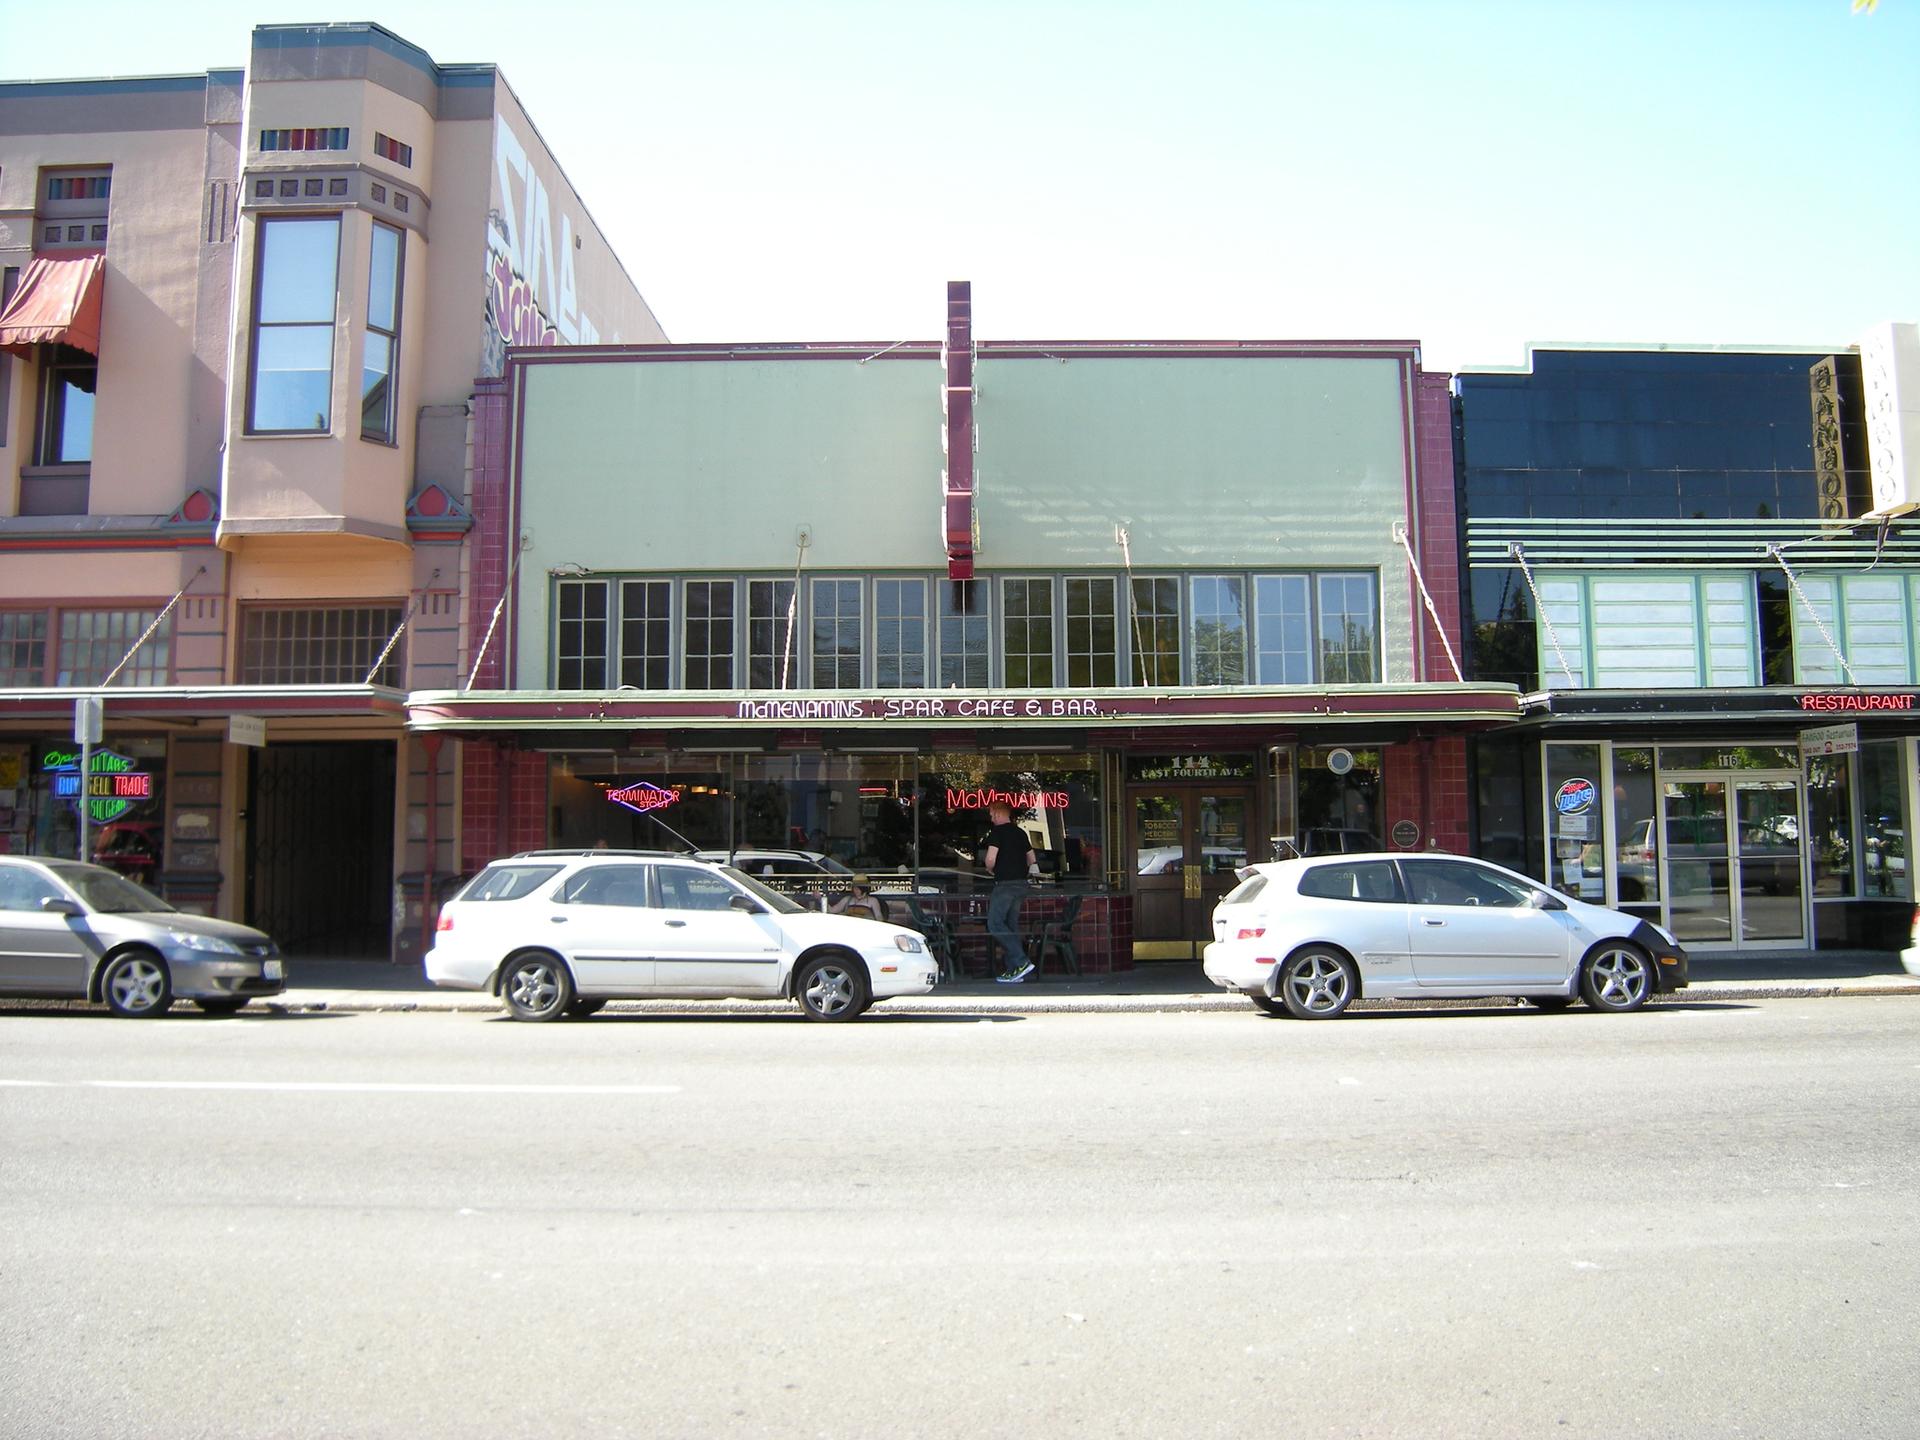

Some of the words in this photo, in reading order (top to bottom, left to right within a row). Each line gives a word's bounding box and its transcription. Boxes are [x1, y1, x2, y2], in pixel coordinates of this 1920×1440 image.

[886, 700, 946, 717] SPAR
[958, 699, 1017, 716] CAFE
[1025, 699, 1042, 716] &
[1052, 699, 1097, 716] BAR
[1802, 694, 1914, 710] RESTAURANT
[1171, 756, 1210, 769] 114
[1719, 755, 1737, 766] 116
[1141, 769, 1171, 779] EAST
[1173, 768, 1217, 777] FOURTH
[58, 776, 80, 795] BUY
[115, 775, 150, 795] TRADE
[606, 789, 681, 802] TERMINATOR
[639, 800, 669, 808] STOUT
